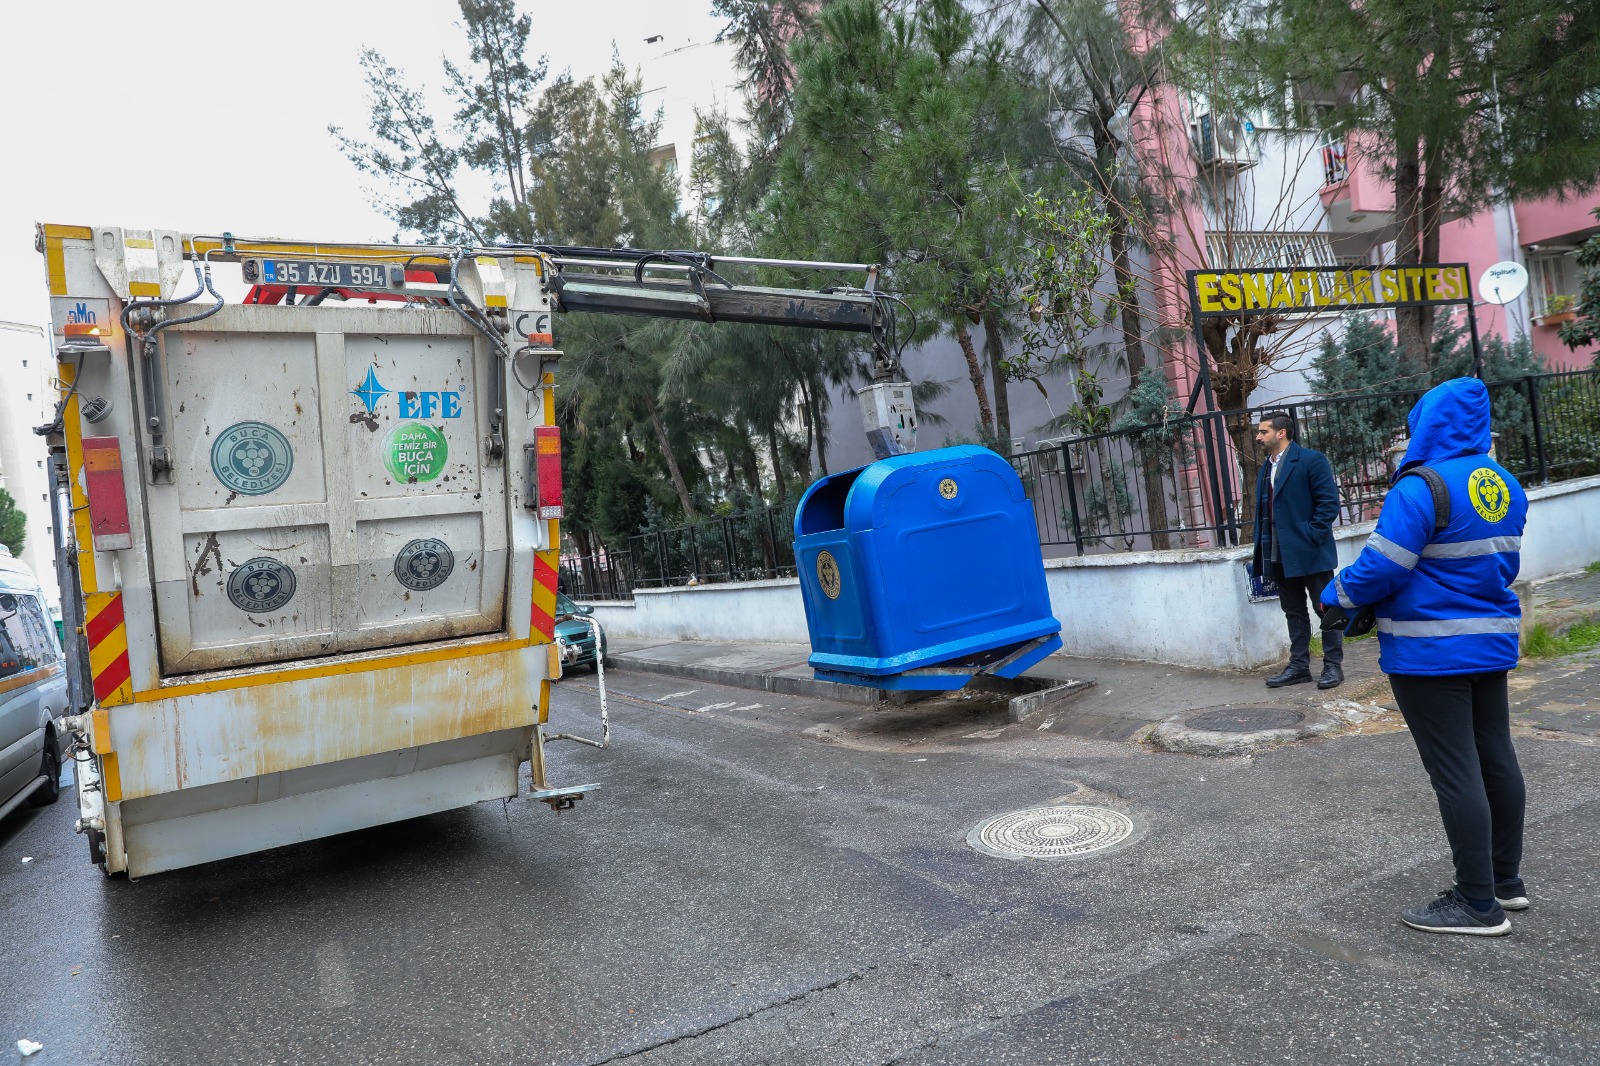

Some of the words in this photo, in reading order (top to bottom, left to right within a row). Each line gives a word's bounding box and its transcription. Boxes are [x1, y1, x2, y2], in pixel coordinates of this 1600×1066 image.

[276, 262, 300, 282] 35
[307, 264, 341, 284] AZU
[350, 265, 384, 286] 594
[1196, 270, 1376, 312] ESNAFLAR
[1380, 266, 1469, 303] SITESI
[515, 313, 549, 338] CE
[397, 391, 462, 419] EFE
[229, 429, 270, 442] BUCA
[401, 432, 428, 441] DAHA
[393, 440, 420, 451] TEMİZ
[422, 440, 437, 449] BİR
[398, 450, 434, 462] BUCA
[403, 462, 430, 476] İÇİN
[1472, 469, 1497, 480] BUCA
[407, 543, 437, 554] BUCA
[247, 562, 282, 573] BUCA
